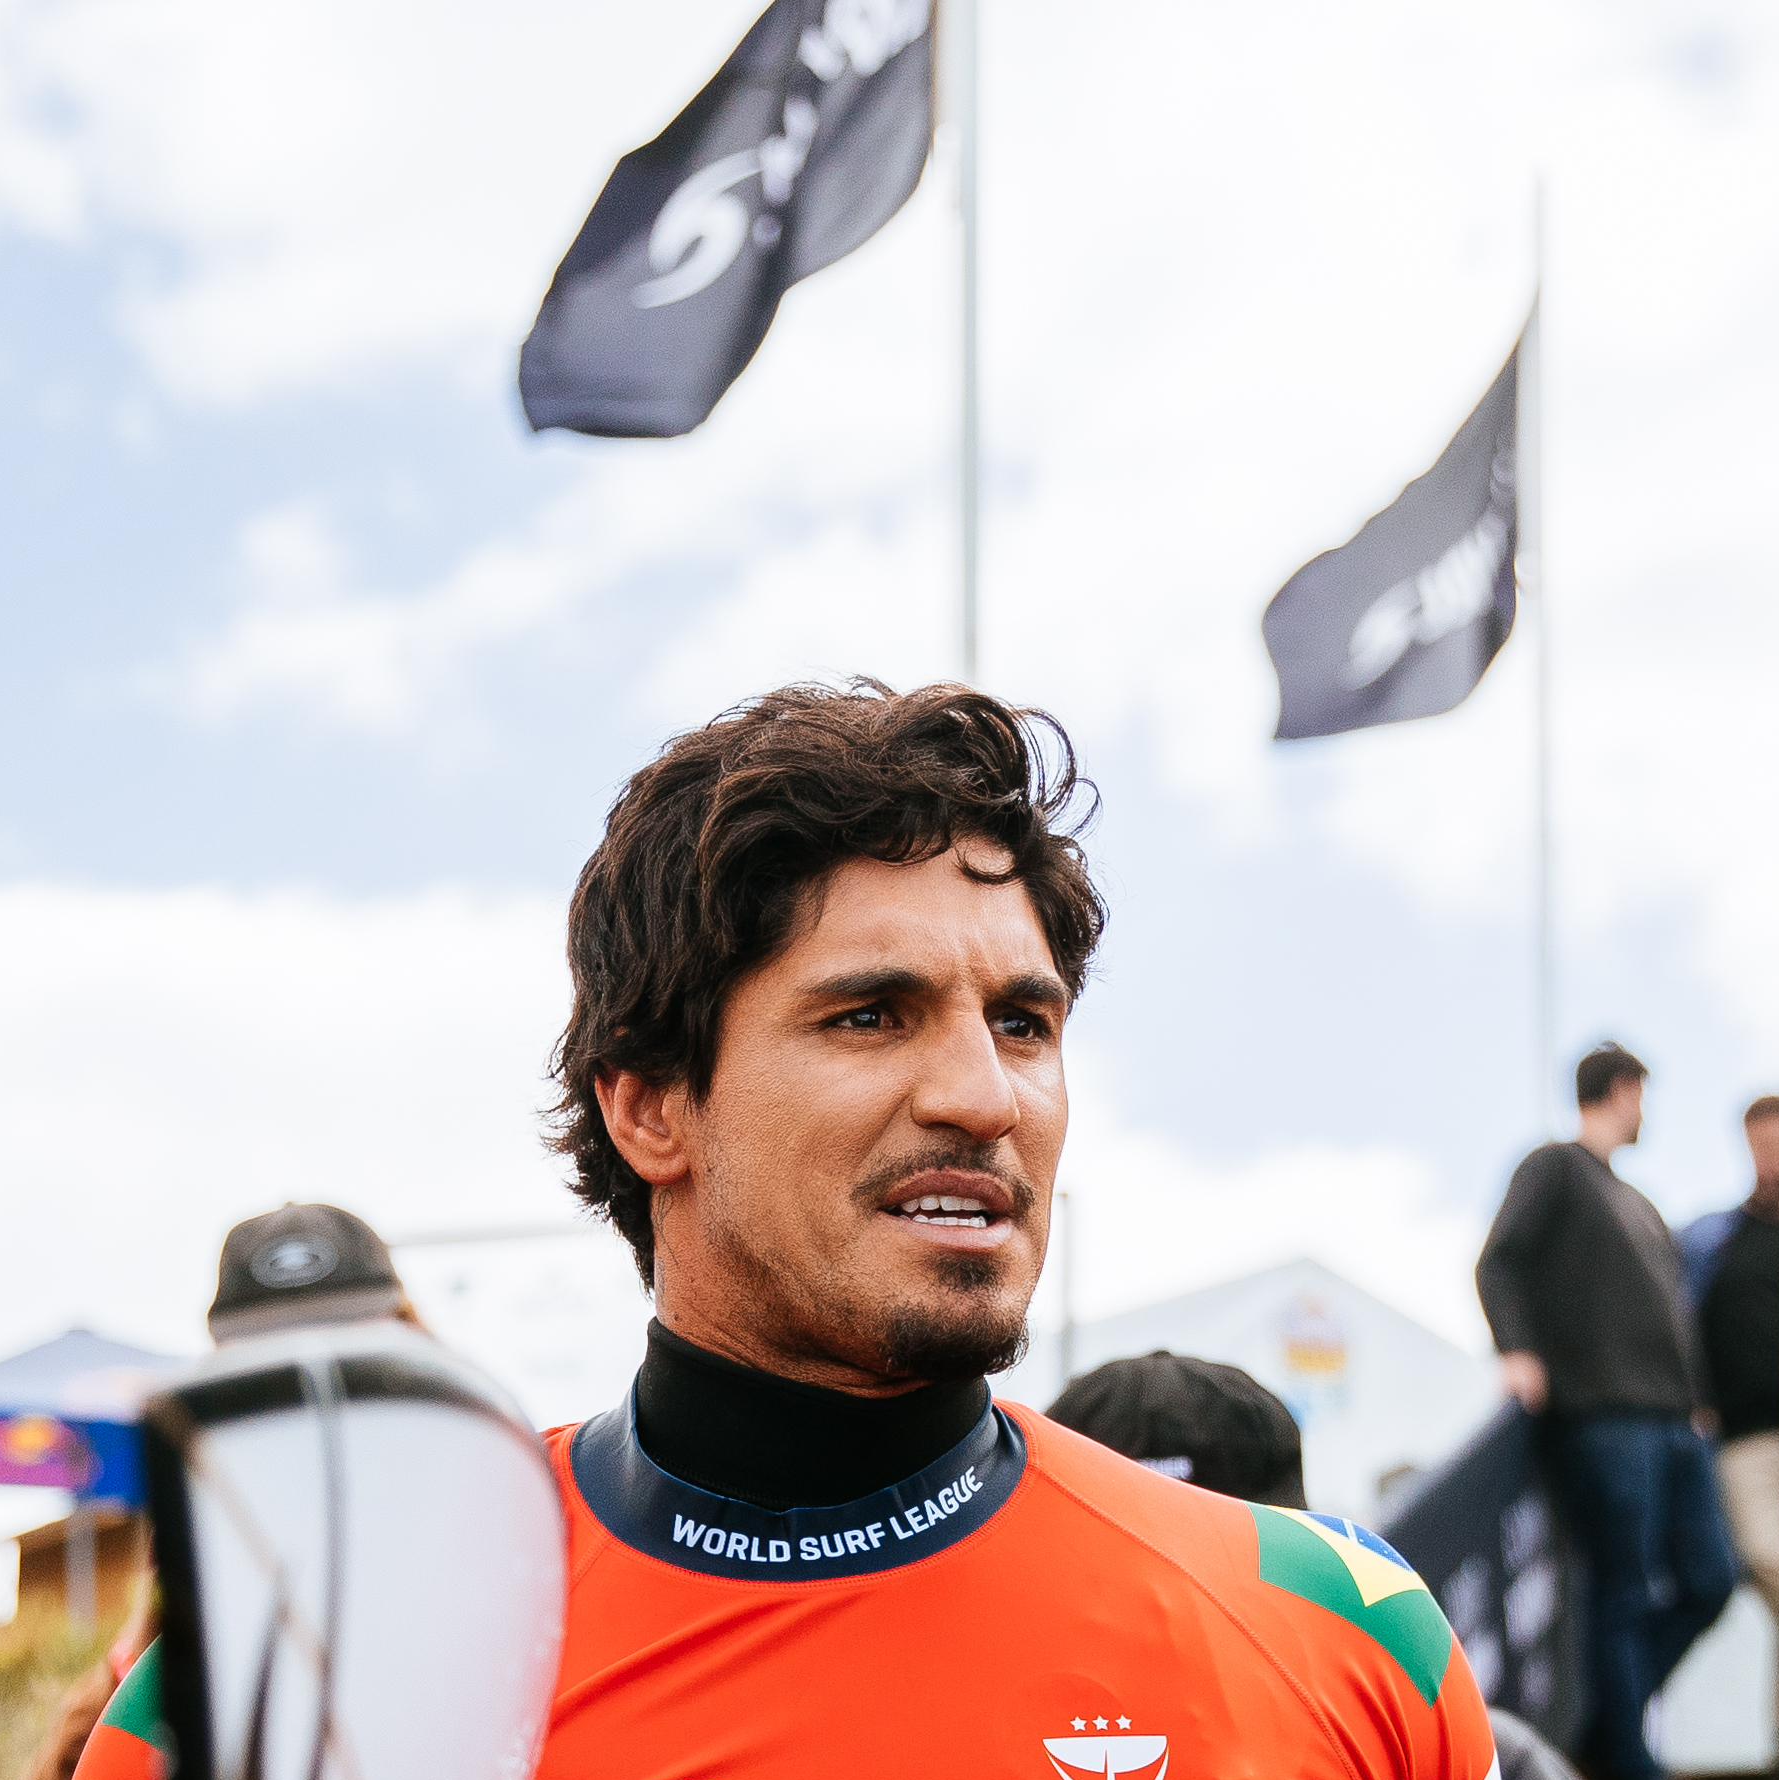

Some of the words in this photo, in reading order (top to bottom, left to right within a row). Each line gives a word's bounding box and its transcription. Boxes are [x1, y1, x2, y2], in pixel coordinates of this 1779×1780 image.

[672, 1514, 791, 1563] WORLD
[799, 1522, 886, 1561] SURF
[888, 1465, 984, 1541] LEAGUE
